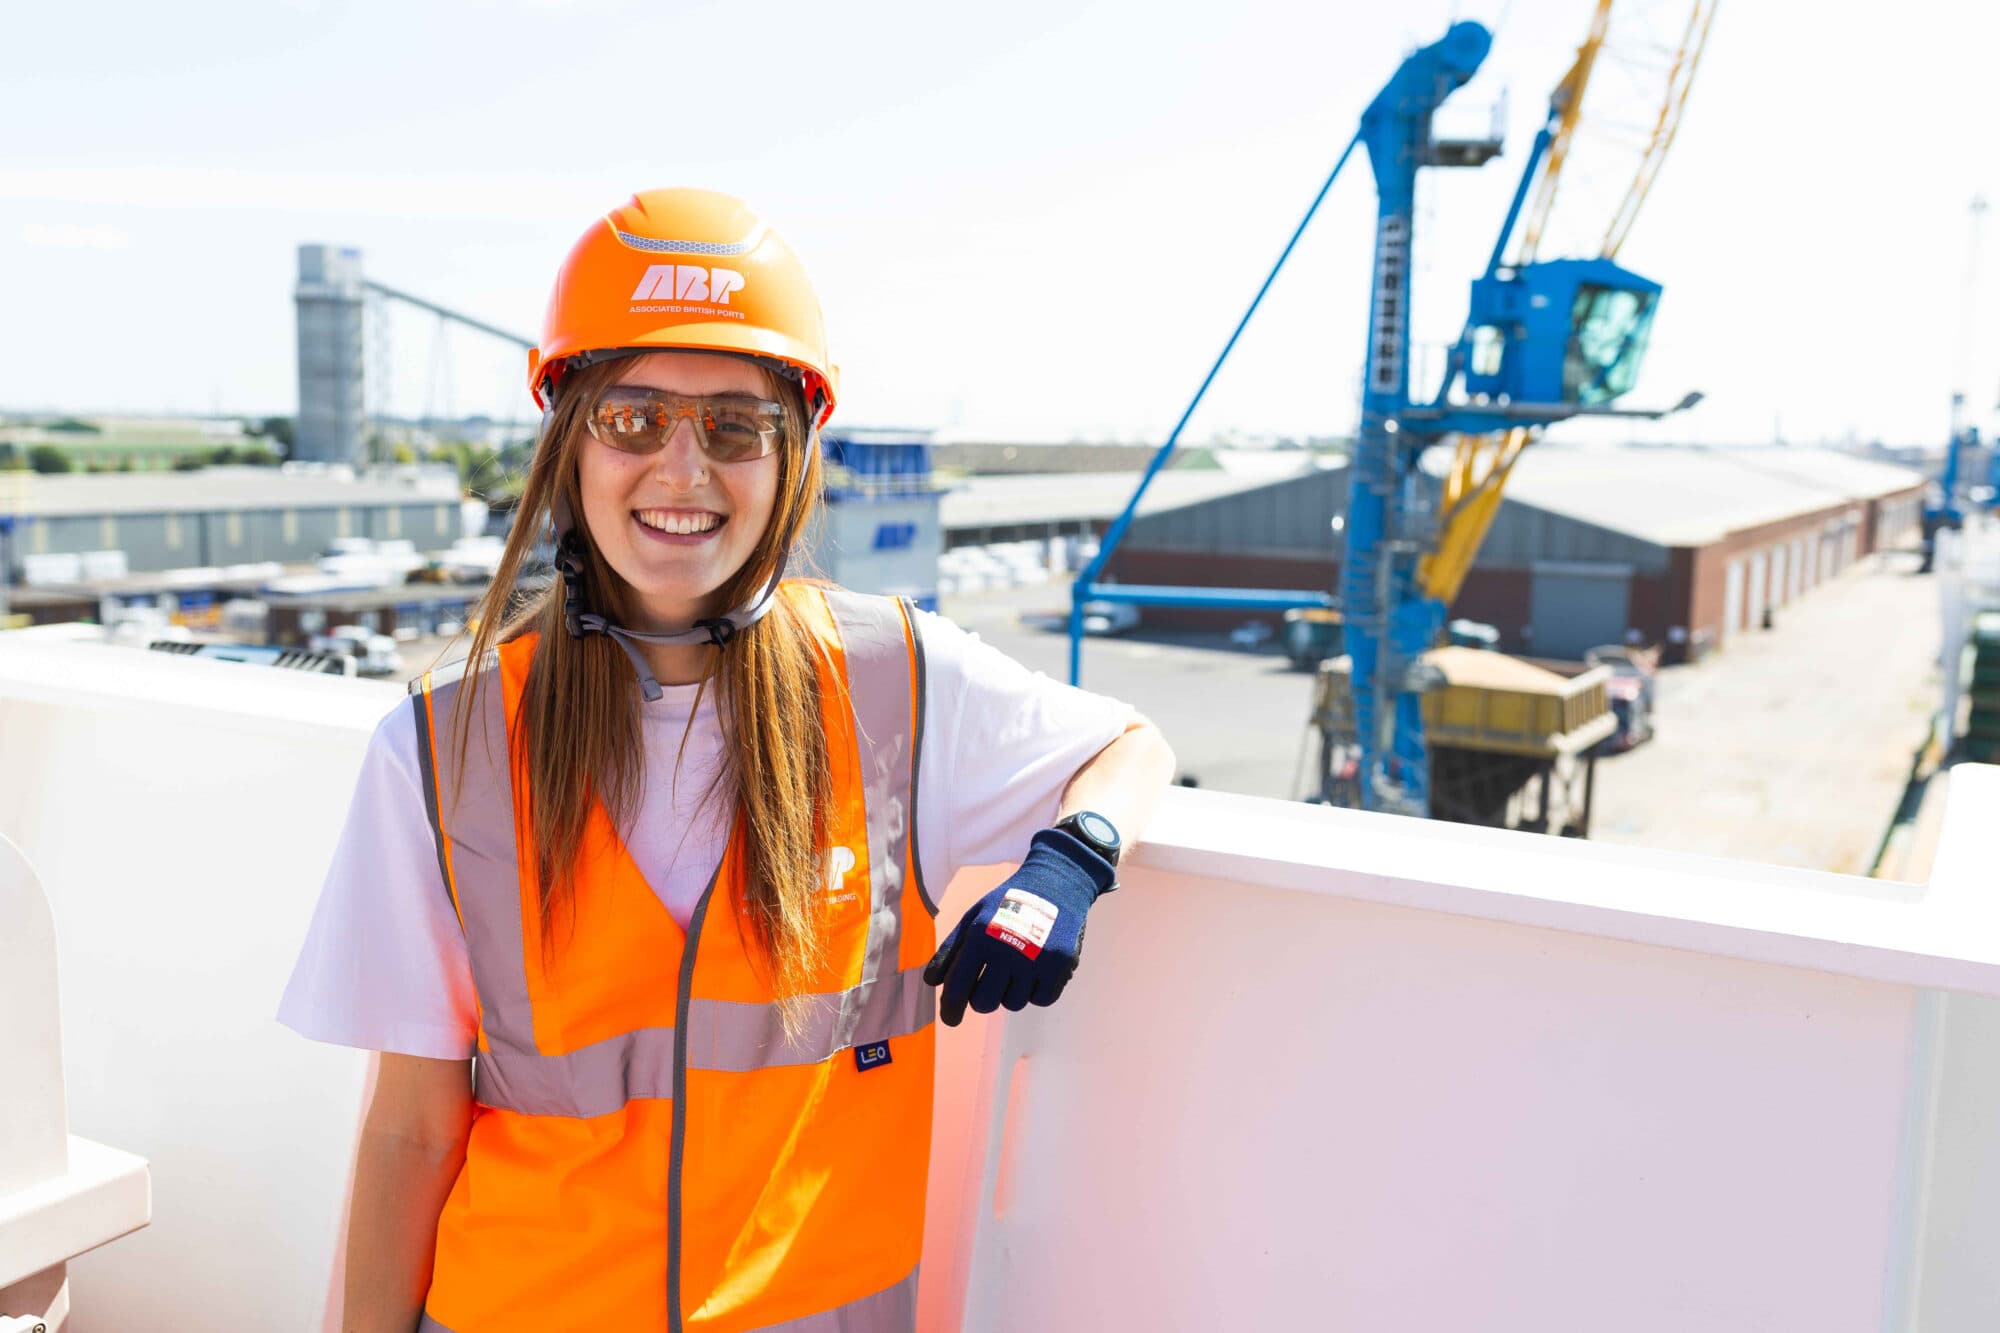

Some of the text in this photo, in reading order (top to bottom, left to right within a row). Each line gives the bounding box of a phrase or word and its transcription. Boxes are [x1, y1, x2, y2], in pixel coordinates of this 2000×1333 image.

[630, 264, 745, 304] ABP
[629, 305, 745, 319] ASSOCIATED BRITISH PORTS
[860, 1046, 886, 1064] LEO
